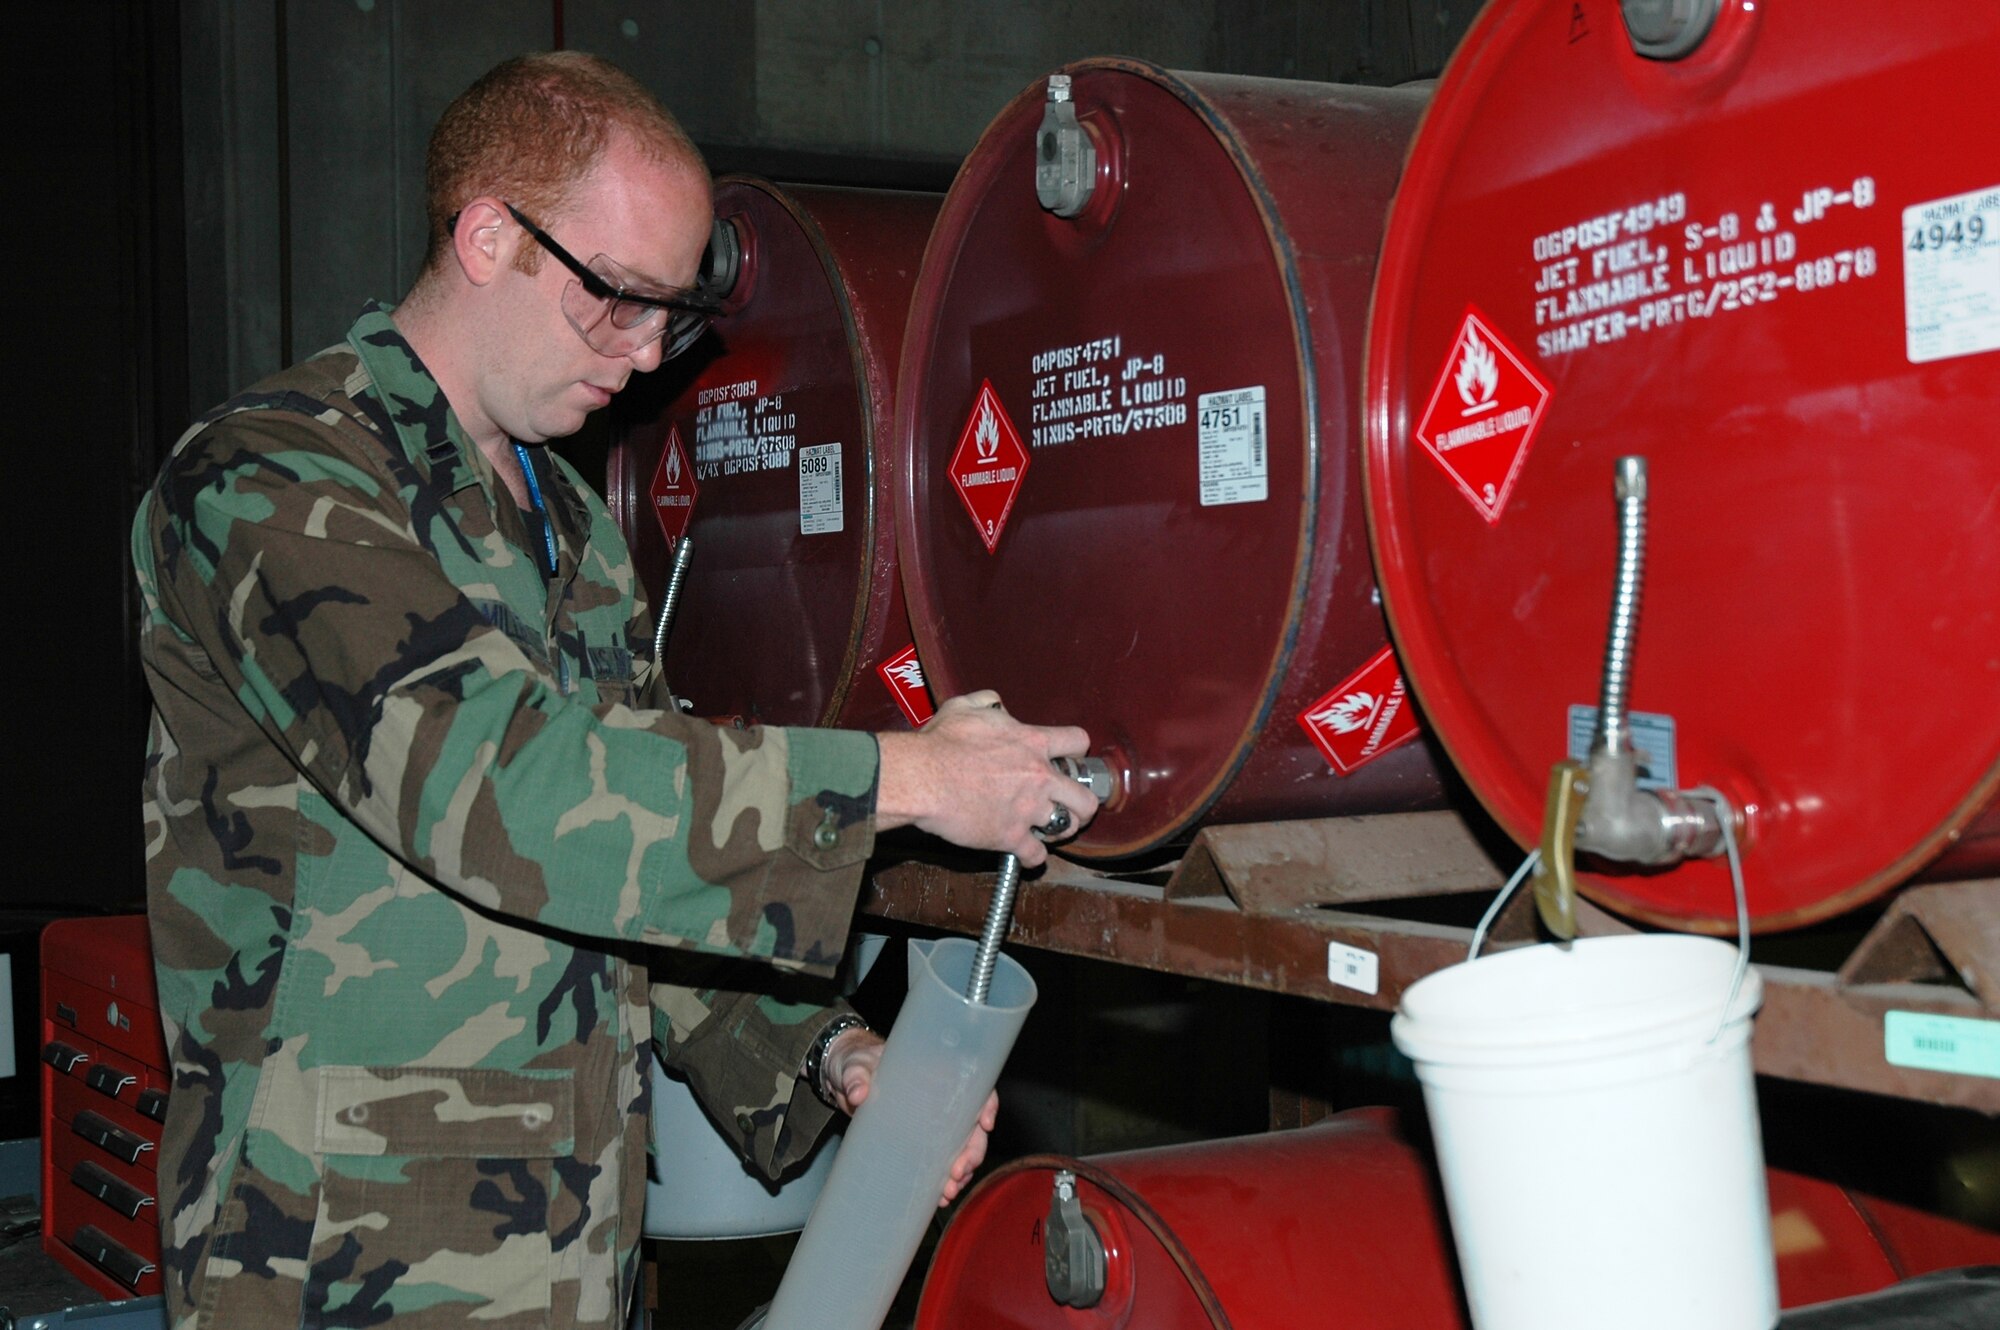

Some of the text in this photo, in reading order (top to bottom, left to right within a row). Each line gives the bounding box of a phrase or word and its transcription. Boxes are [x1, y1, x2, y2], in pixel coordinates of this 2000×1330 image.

[1535, 176, 1875, 293] JET FUEL, S-8 & JP-8
[1907, 215, 1984, 253] 4949
[1535, 230, 1796, 326] FLAMMABLE LIQUID
[1032, 354, 1164, 399] JET FUEL, JP-8
[696, 395, 782, 424] JET FUEL, JP-8
[1032, 376, 1187, 424] FLAMMABLE LIQUID
[696, 413, 796, 443] FLAMMABLE LIQUID
[1201, 406, 1240, 429] 4751
[1435, 405, 1532, 453] FLAMMABLE LIQUID
[801, 456, 828, 474] 5089
[962, 467, 1016, 487] FLAMMABLE LIQUID
[1483, 482, 1496, 506] 3
[671, 535, 677, 548] 3
[986, 519, 994, 536] 3
[1031, 1217, 1041, 1246] A
